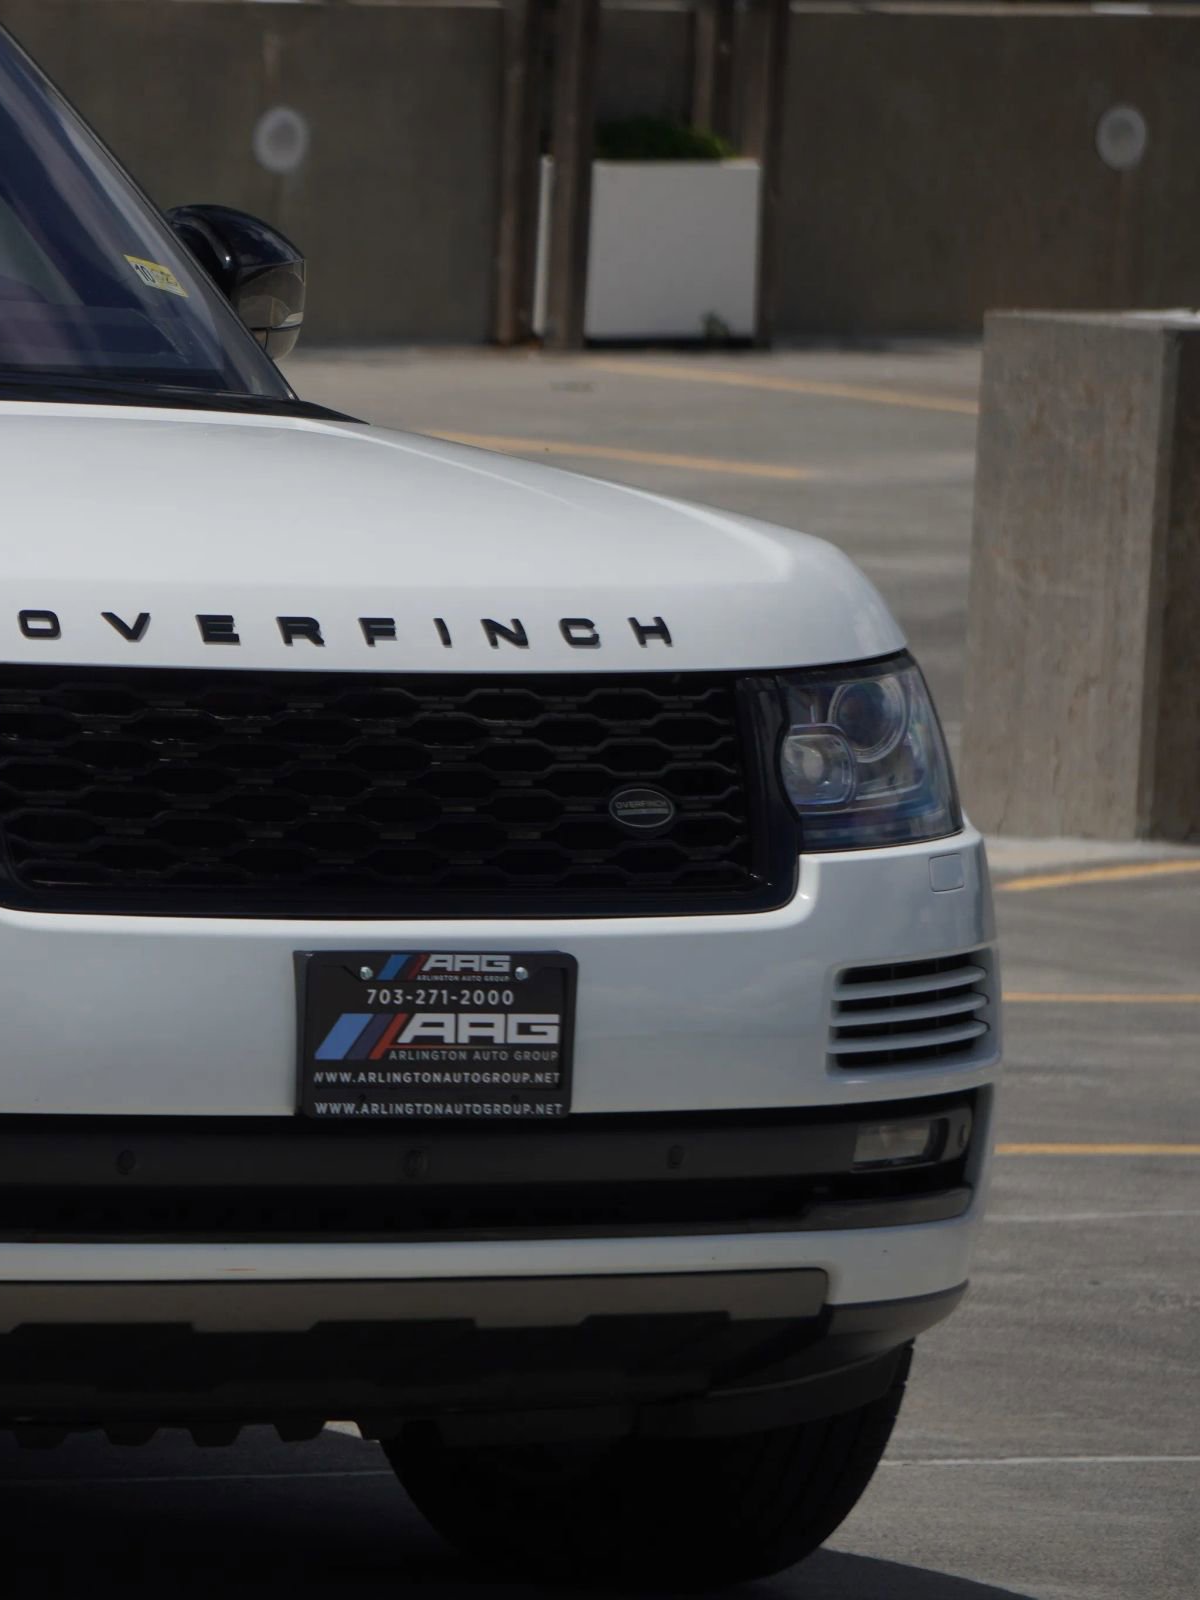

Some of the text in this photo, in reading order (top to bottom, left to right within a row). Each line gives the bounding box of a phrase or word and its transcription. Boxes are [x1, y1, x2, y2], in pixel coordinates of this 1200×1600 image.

[18, 609, 672, 648] OVERFINCH
[421, 954, 511, 972] AAG
[416, 974, 459, 982] ARLINGTON
[461, 974, 482, 982] AUTO
[366, 989, 515, 1005] 703-271-2000
[397, 1013, 560, 1044] AAG
[388, 1050, 559, 1061] ARLINGTON AUTO GROUP
[313, 1071, 560, 1084] WWW.ARLINGTONAUTOGROUP.NET
[314, 1102, 563, 1115] WWW.ARLINGTONAUTOGROUP.NET
